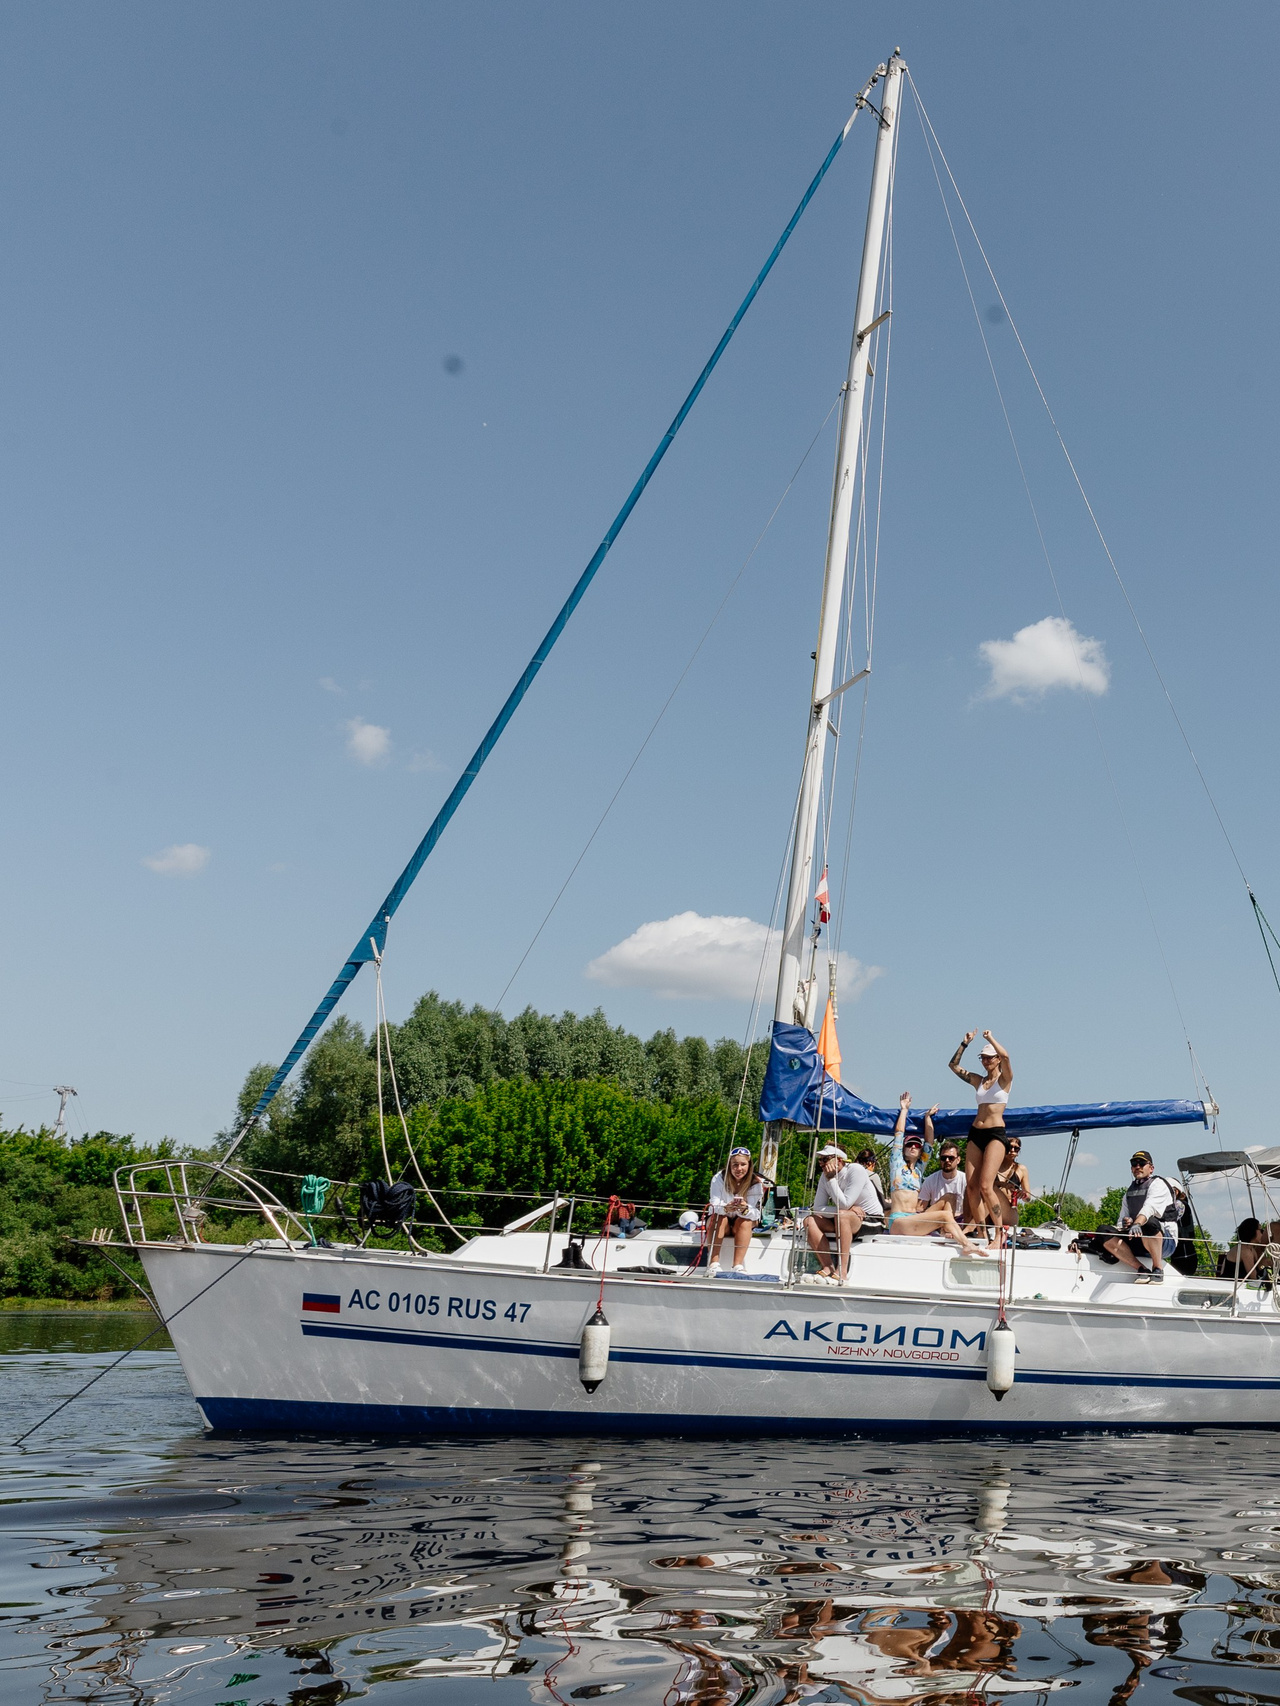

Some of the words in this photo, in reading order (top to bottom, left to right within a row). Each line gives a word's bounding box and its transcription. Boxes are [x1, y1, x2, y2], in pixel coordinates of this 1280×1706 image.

[388, 1291, 440, 1316] 0105
[447, 1297, 497, 1321] RUS
[503, 1302, 532, 1324] 47
[763, 1319, 1021, 1354] АКСИОМ
[827, 1345, 879, 1357] NIZHNY
[883, 1348, 960, 1362] NOVGOROD
